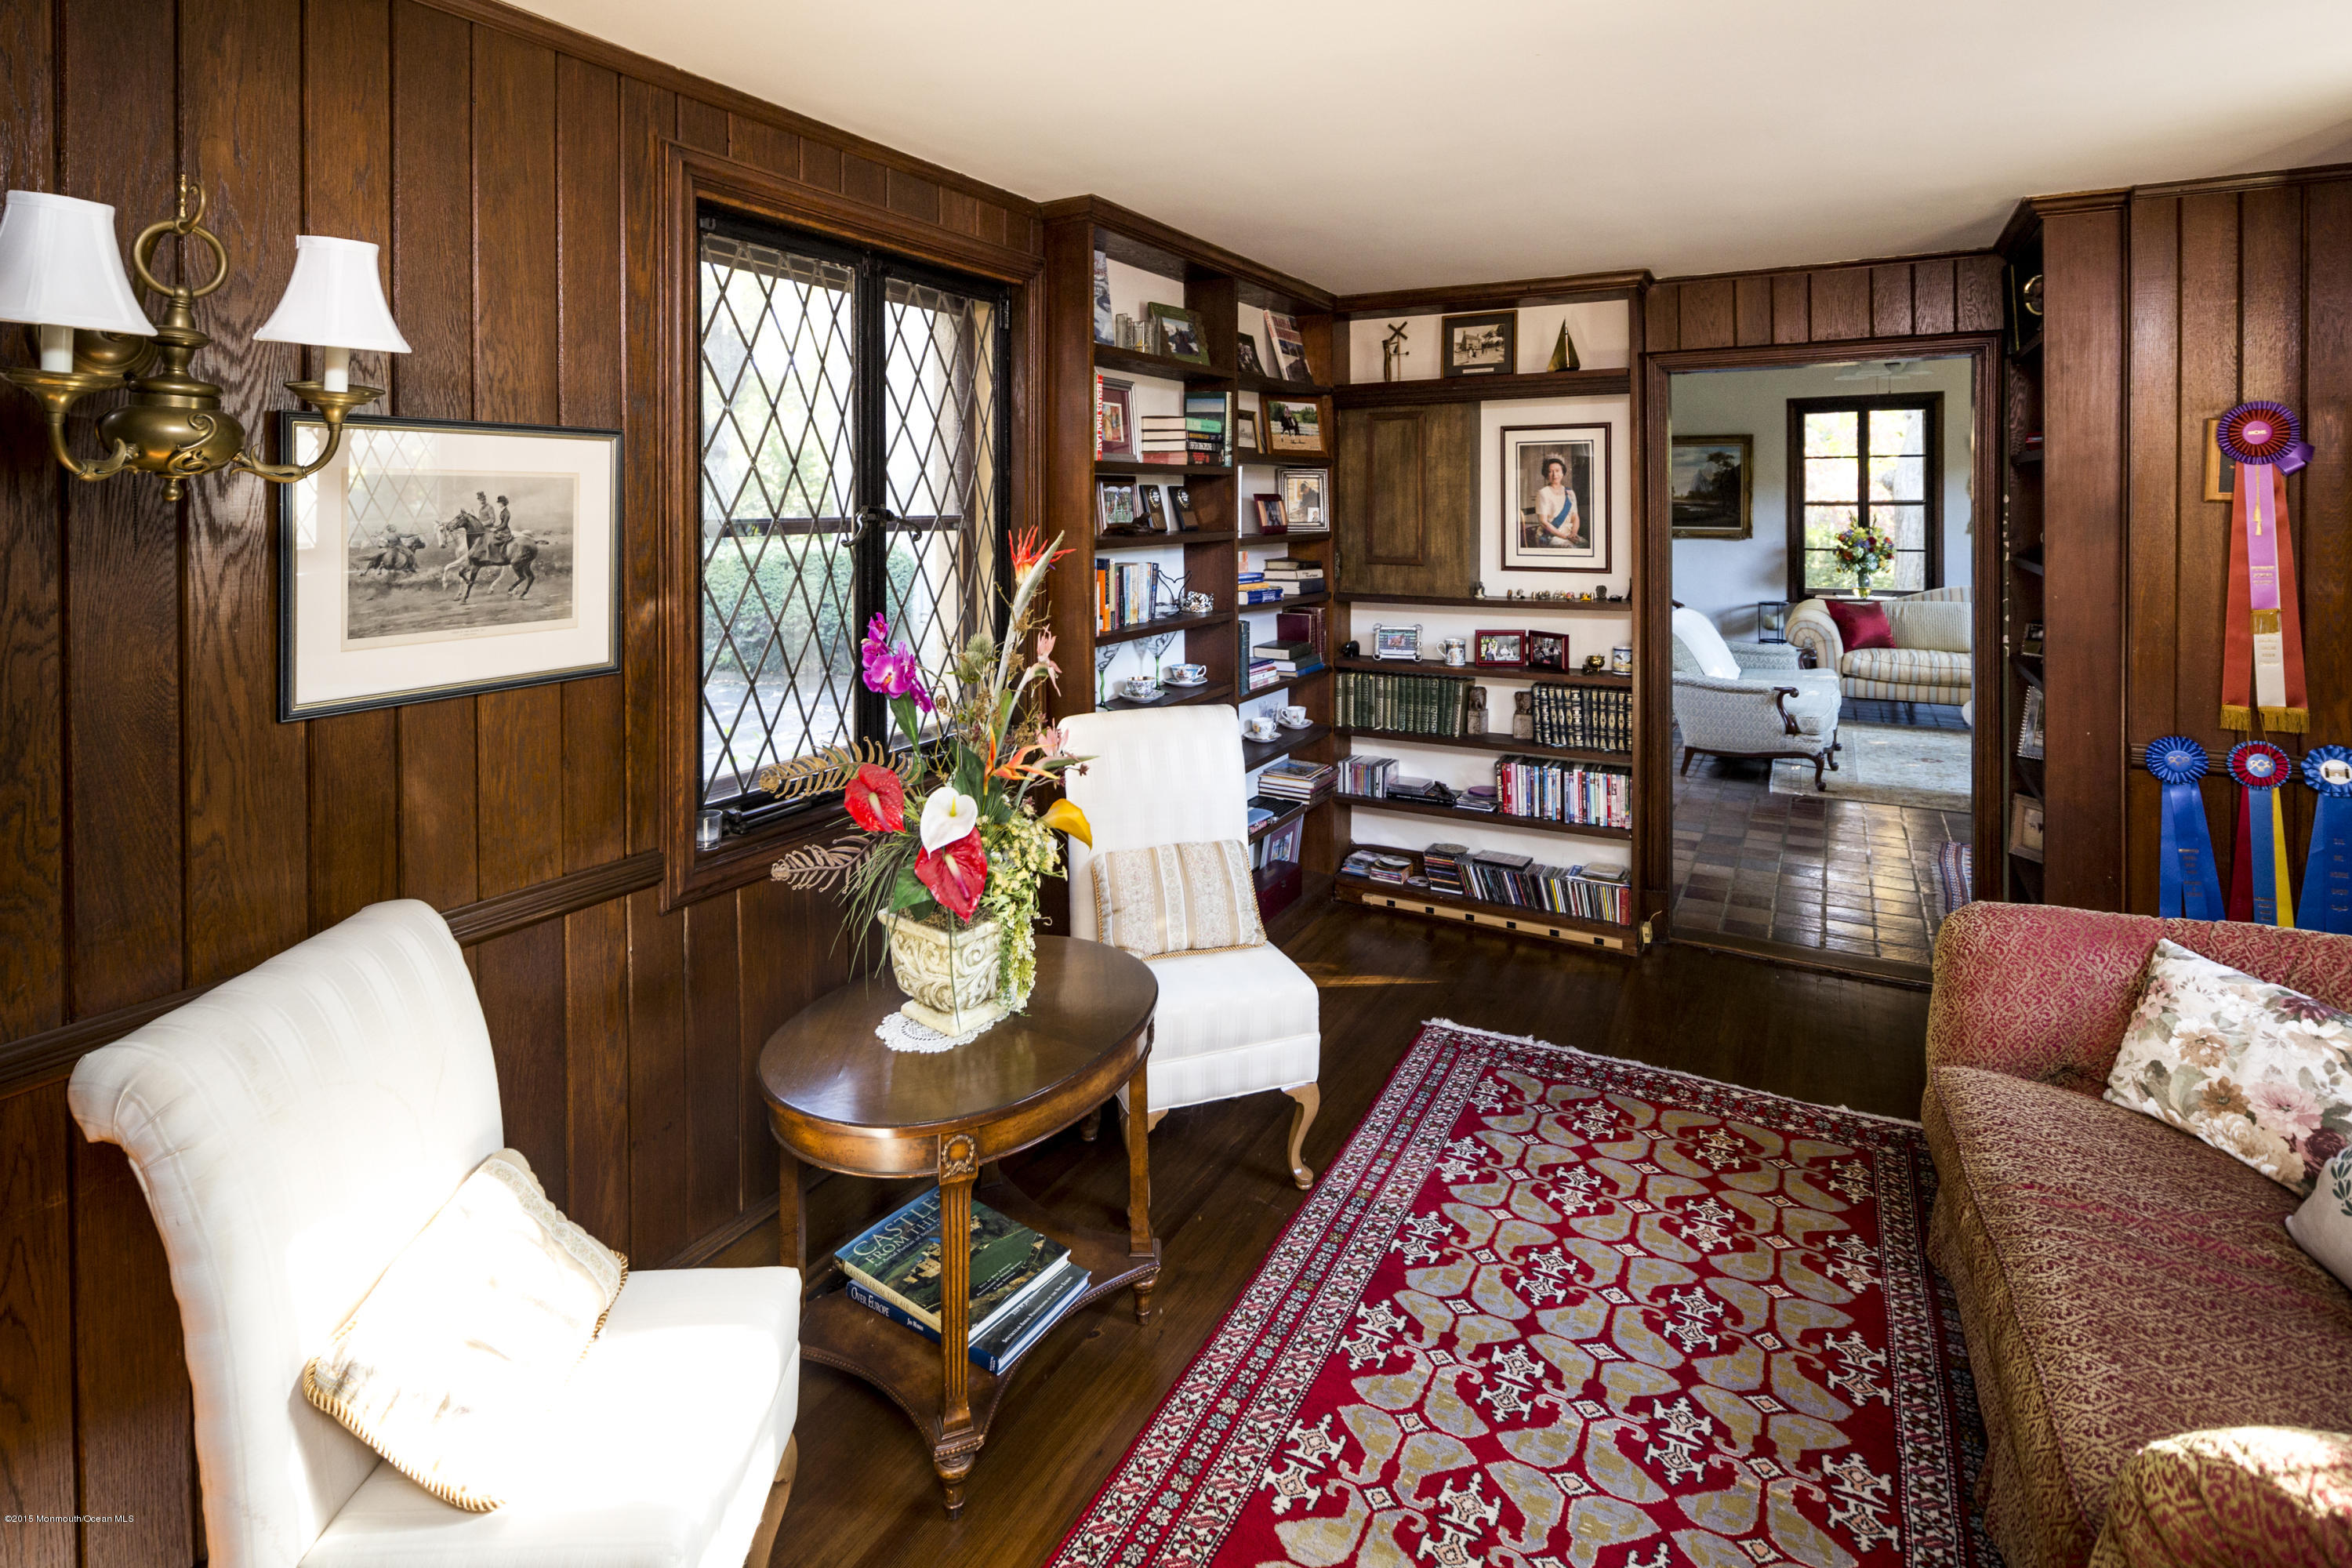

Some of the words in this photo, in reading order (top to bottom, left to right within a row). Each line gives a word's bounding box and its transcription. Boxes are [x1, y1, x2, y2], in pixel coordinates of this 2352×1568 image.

[865, 1236, 910, 1264] FROM
[909, 1214, 939, 1235] THE
[851, 1287, 868, 1307] OVER
[868, 1294, 890, 1317] EUROPE
